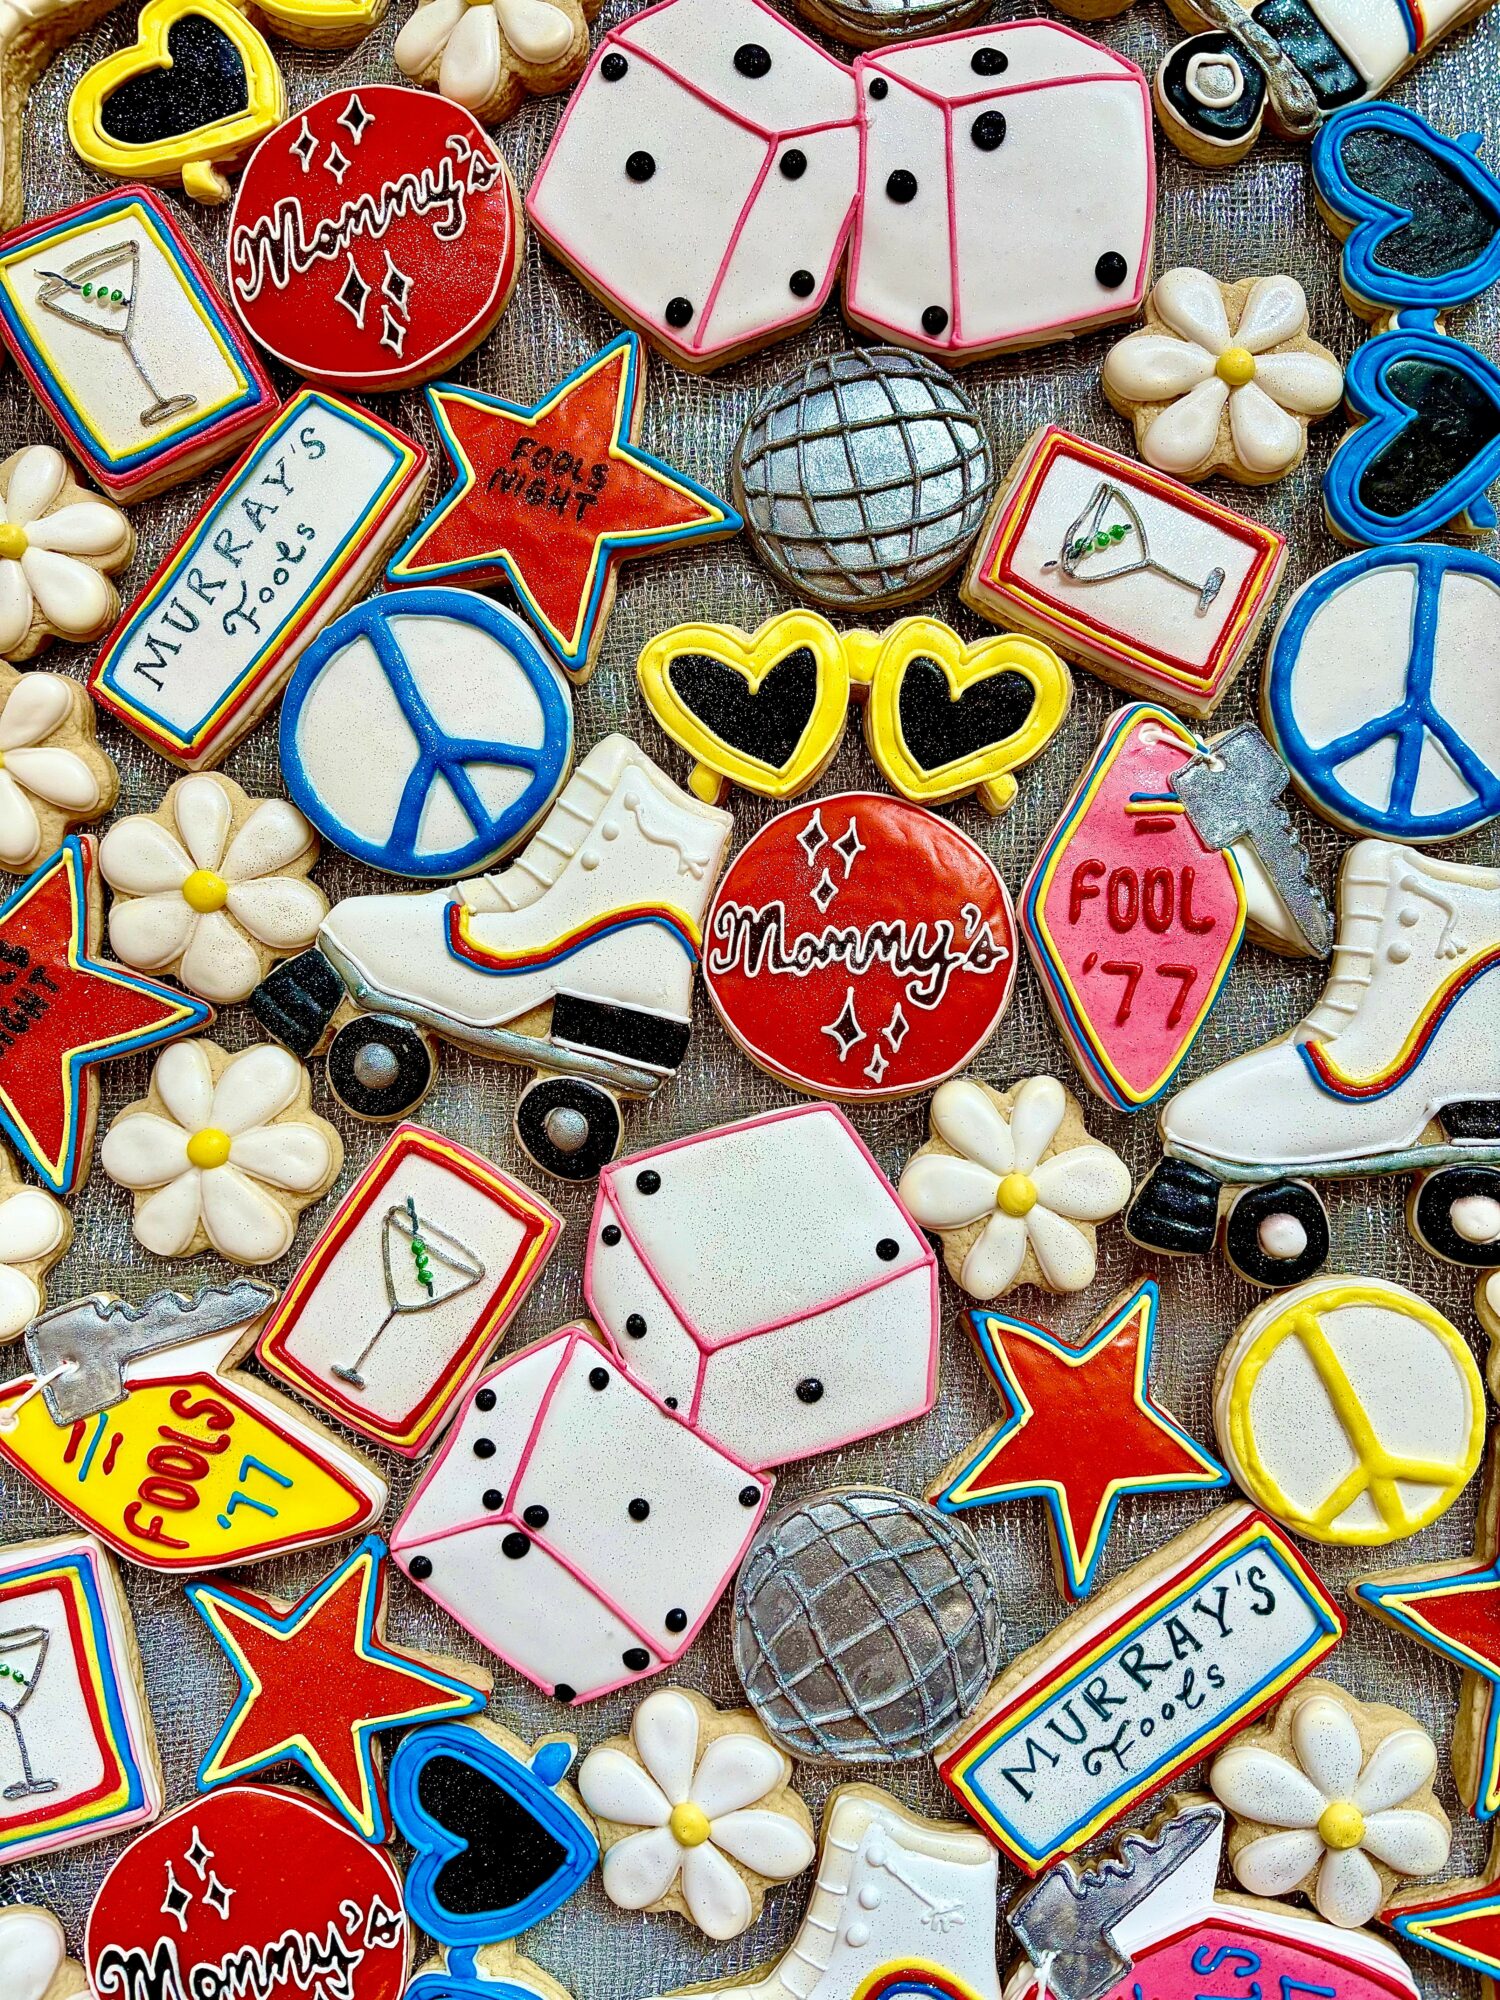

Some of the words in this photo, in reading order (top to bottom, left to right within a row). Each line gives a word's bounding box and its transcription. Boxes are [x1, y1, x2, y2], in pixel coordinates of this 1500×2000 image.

[487, 466, 599, 523] NIGHT
[510, 436, 609, 493] FOOLS
[133, 427, 326, 692] MURRAY'S
[222, 522, 316, 637] Fools
[1068, 858, 1217, 935] FOOL
[1082, 951, 1199, 1030] '77
[1000, 1565, 1276, 1803] MURRAY'S
[1082, 1663, 1225, 1777] Fools
